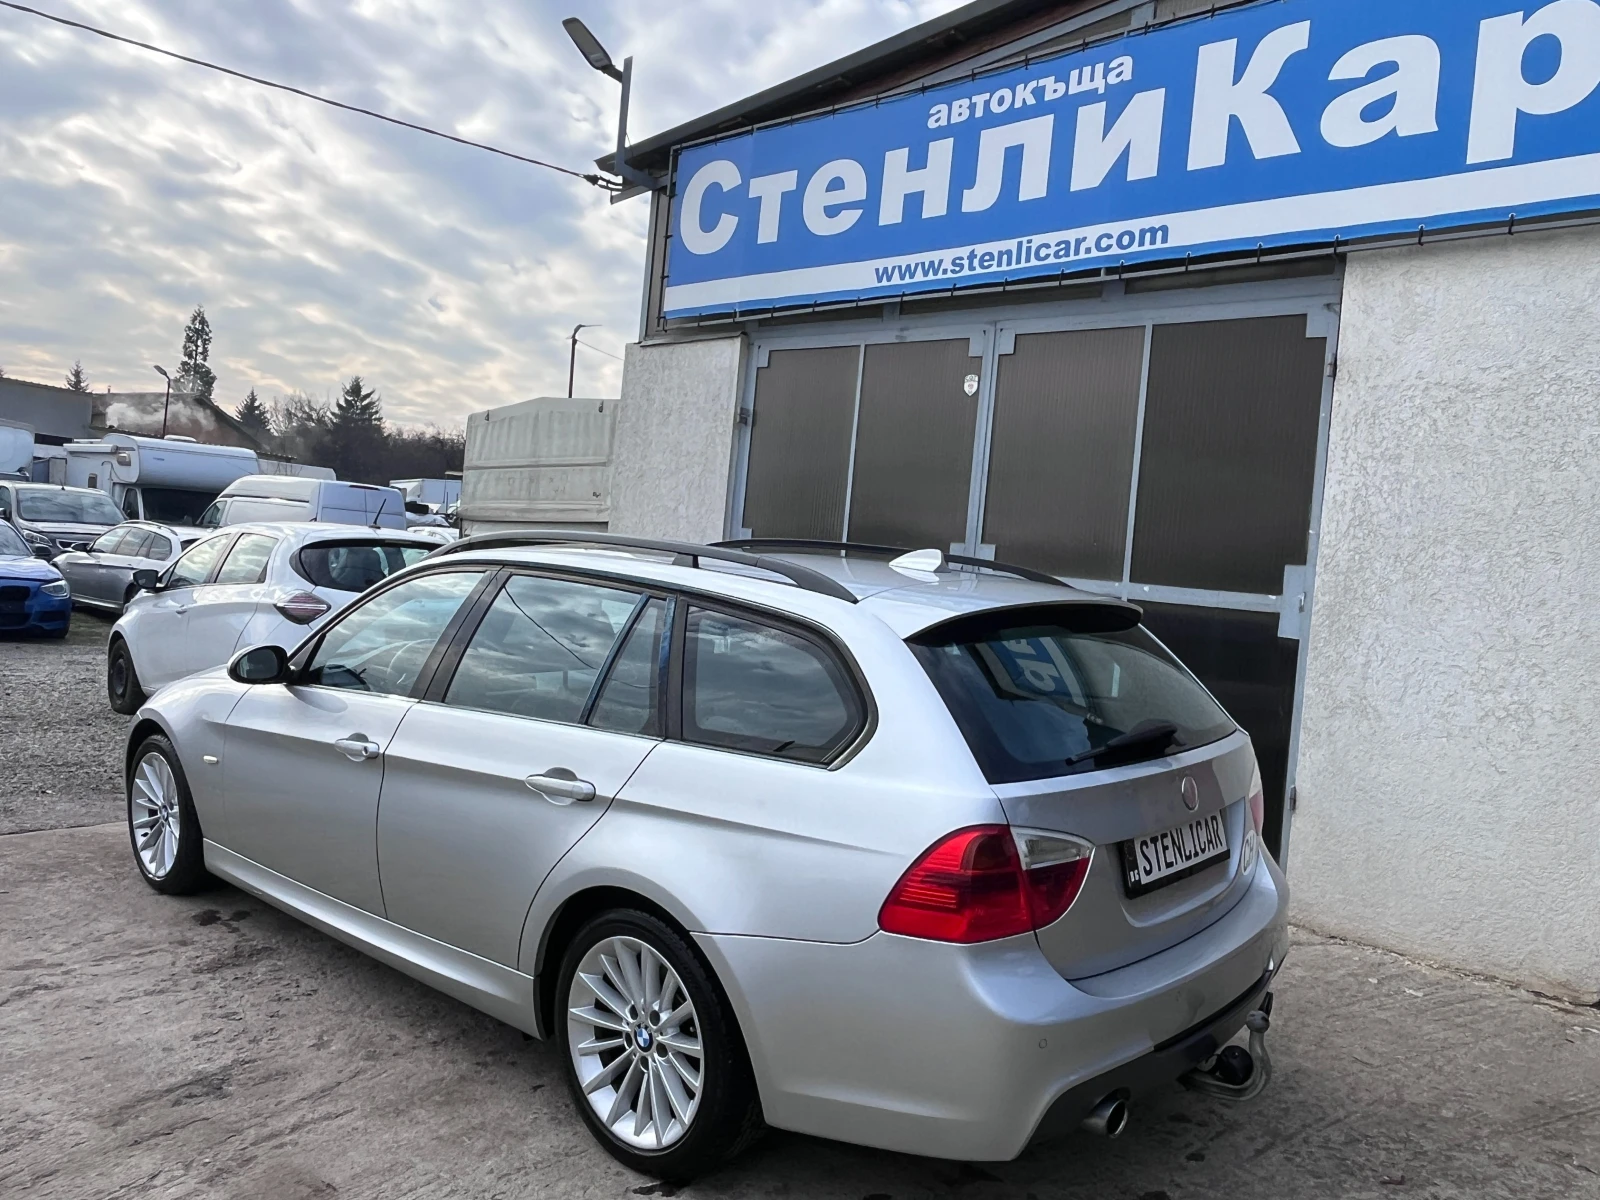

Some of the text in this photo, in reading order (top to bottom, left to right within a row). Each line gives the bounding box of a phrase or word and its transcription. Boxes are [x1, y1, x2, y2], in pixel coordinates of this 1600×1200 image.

[928, 55, 1133, 129] автокъща
[679, 0, 1600, 255] СтенлиКар
[875, 223, 1168, 283] www.stenlicar.com
[1140, 815, 1222, 876] STENLICAR
